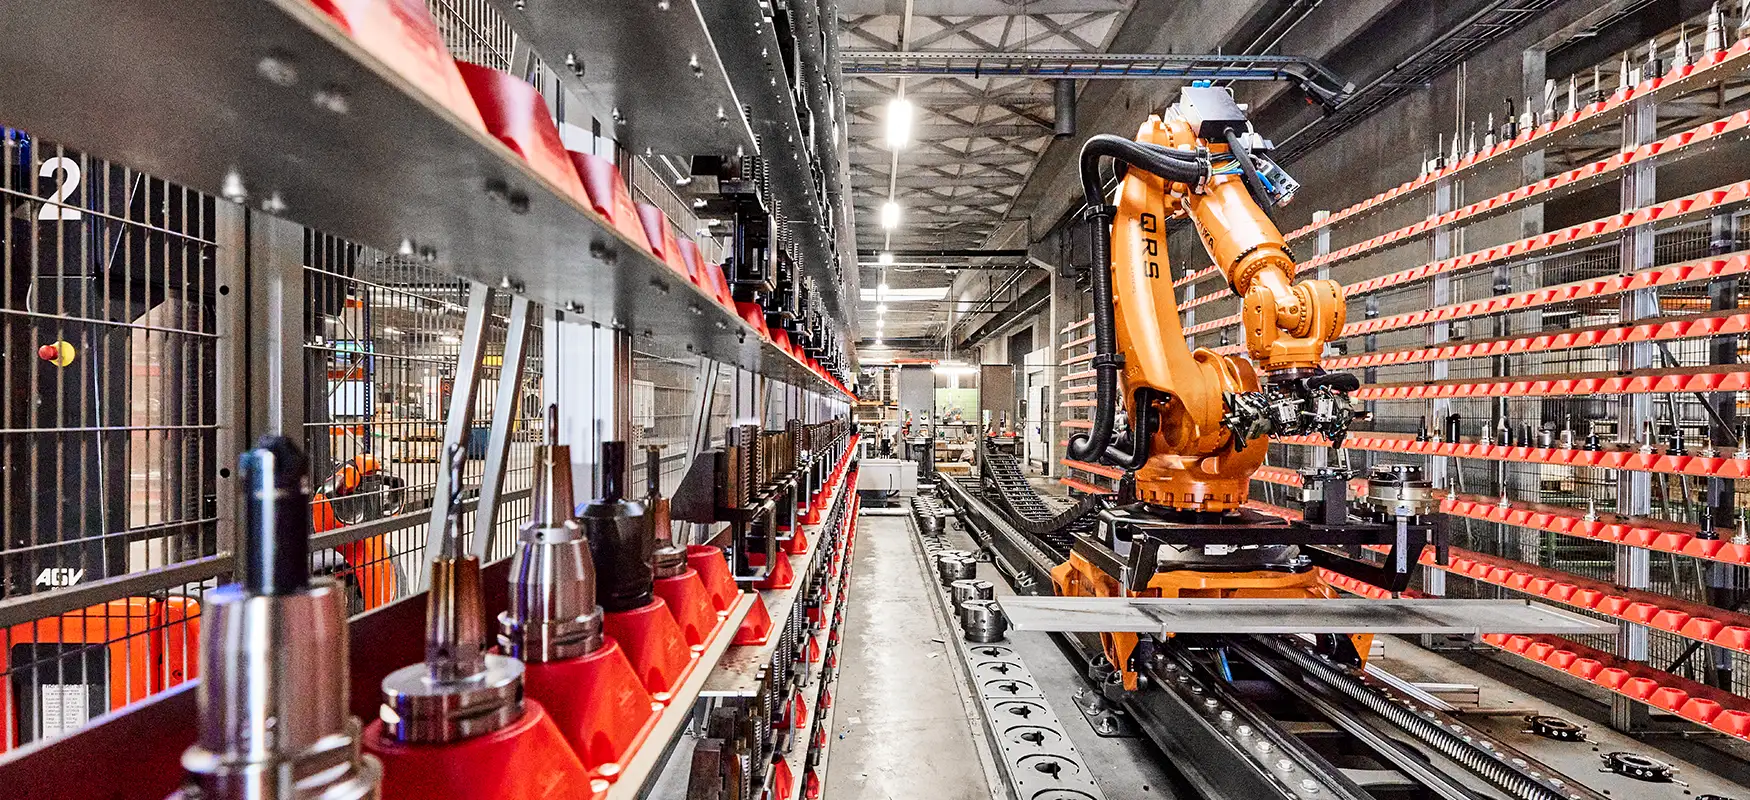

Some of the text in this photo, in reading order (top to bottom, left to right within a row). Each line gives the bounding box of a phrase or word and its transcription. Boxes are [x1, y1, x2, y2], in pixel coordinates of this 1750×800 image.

[38, 156, 82, 221] 2
[1139, 212, 1160, 279] QRS
[35, 567, 86, 586] AGV
